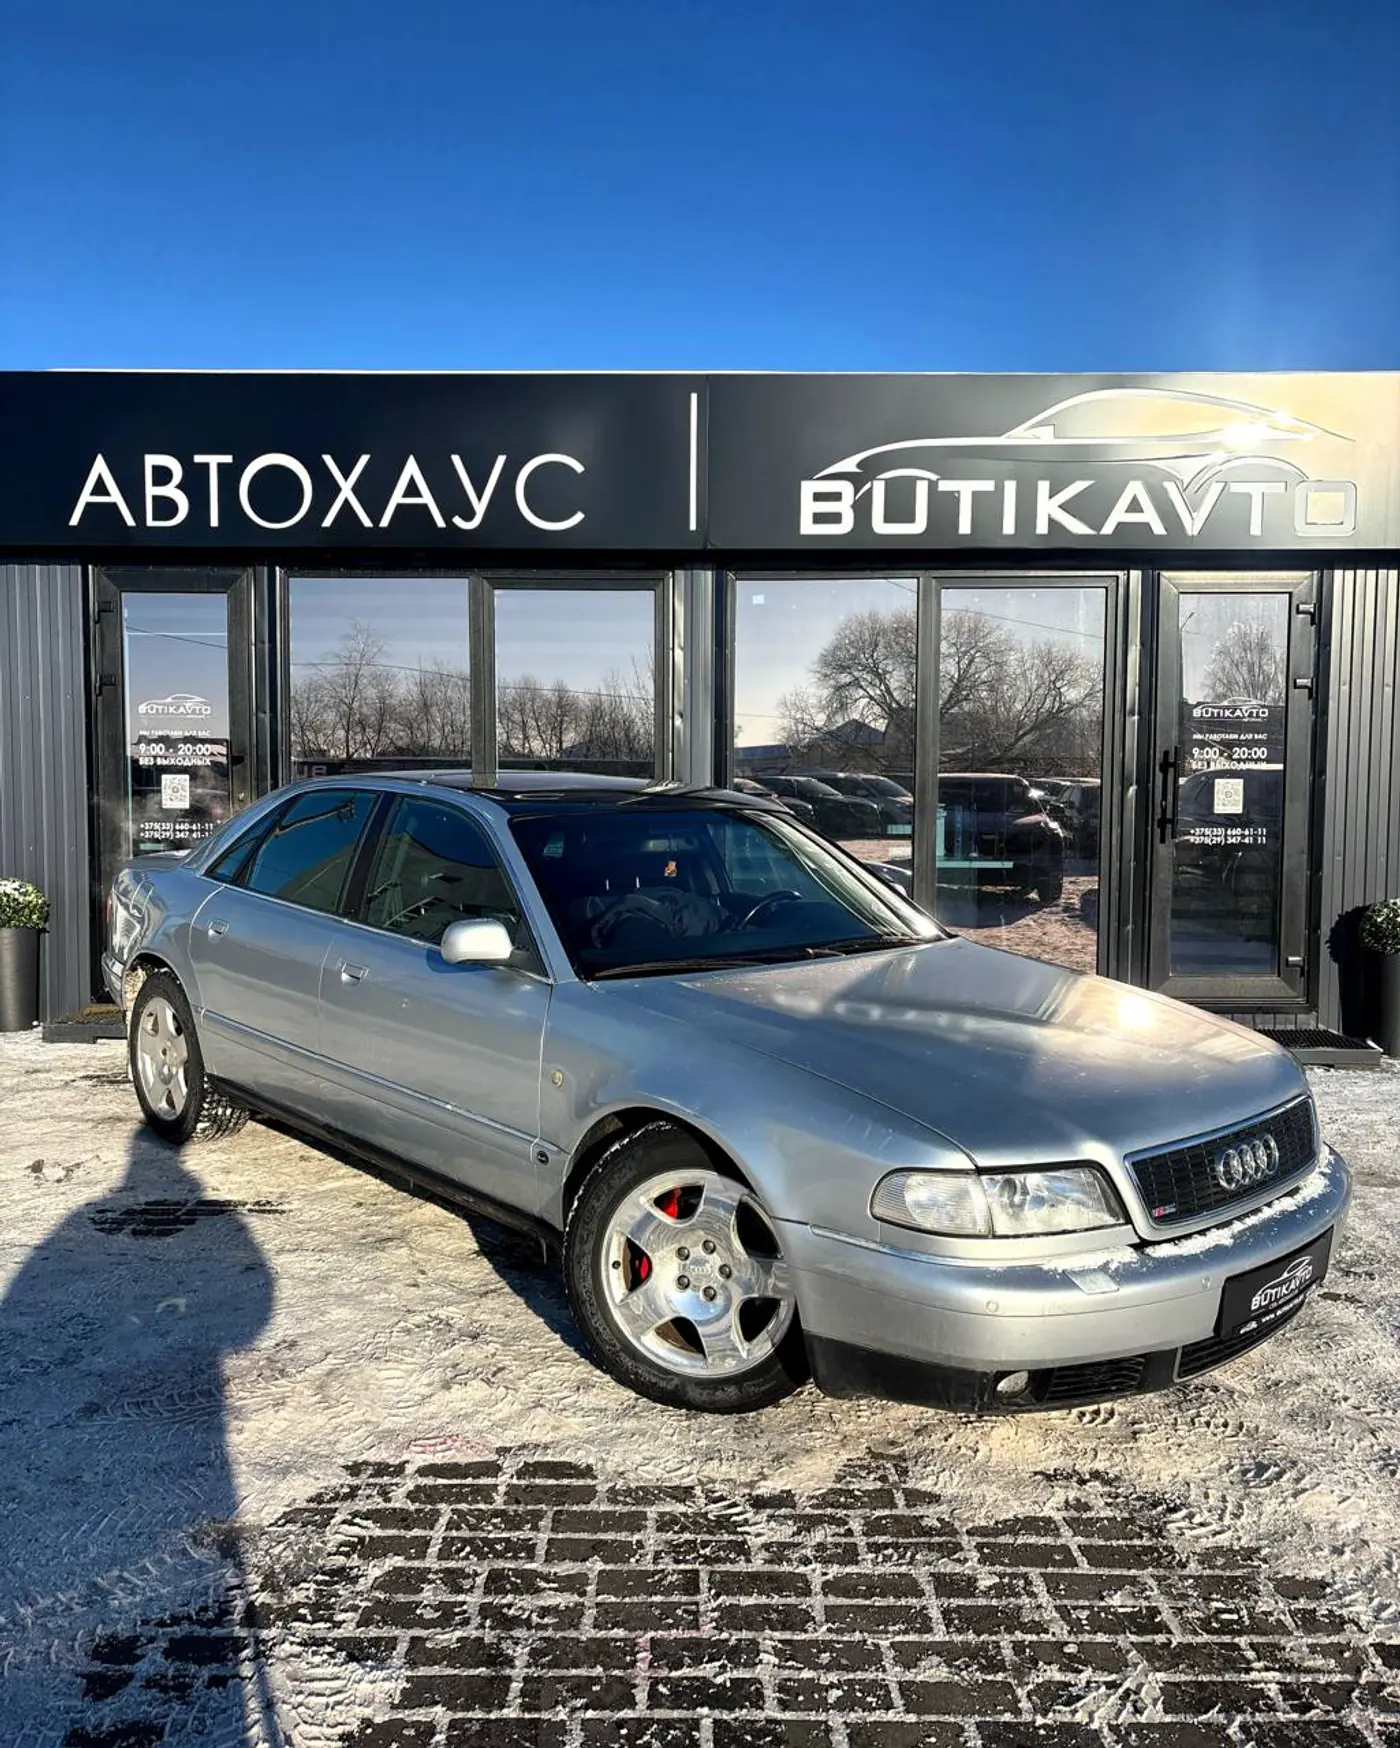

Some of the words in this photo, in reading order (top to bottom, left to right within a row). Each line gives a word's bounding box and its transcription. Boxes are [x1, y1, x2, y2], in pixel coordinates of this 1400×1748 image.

[68, 452, 586, 531] АВТОХАУС
[799, 478, 1358, 537] BUTIKAVTO
[138, 704, 211, 714] BUTIKAVTO
[1192, 708, 1268, 717] BUTIKAVTO
[139, 743, 165, 755] 9:00
[178, 743, 212, 755] 20:00
[1192, 748, 1219, 759] 9:00
[1232, 748, 1267, 759] 20:00
[139, 757, 154, 765] БЕЗ
[156, 757, 212, 766] ВЫХОДНЫХ
